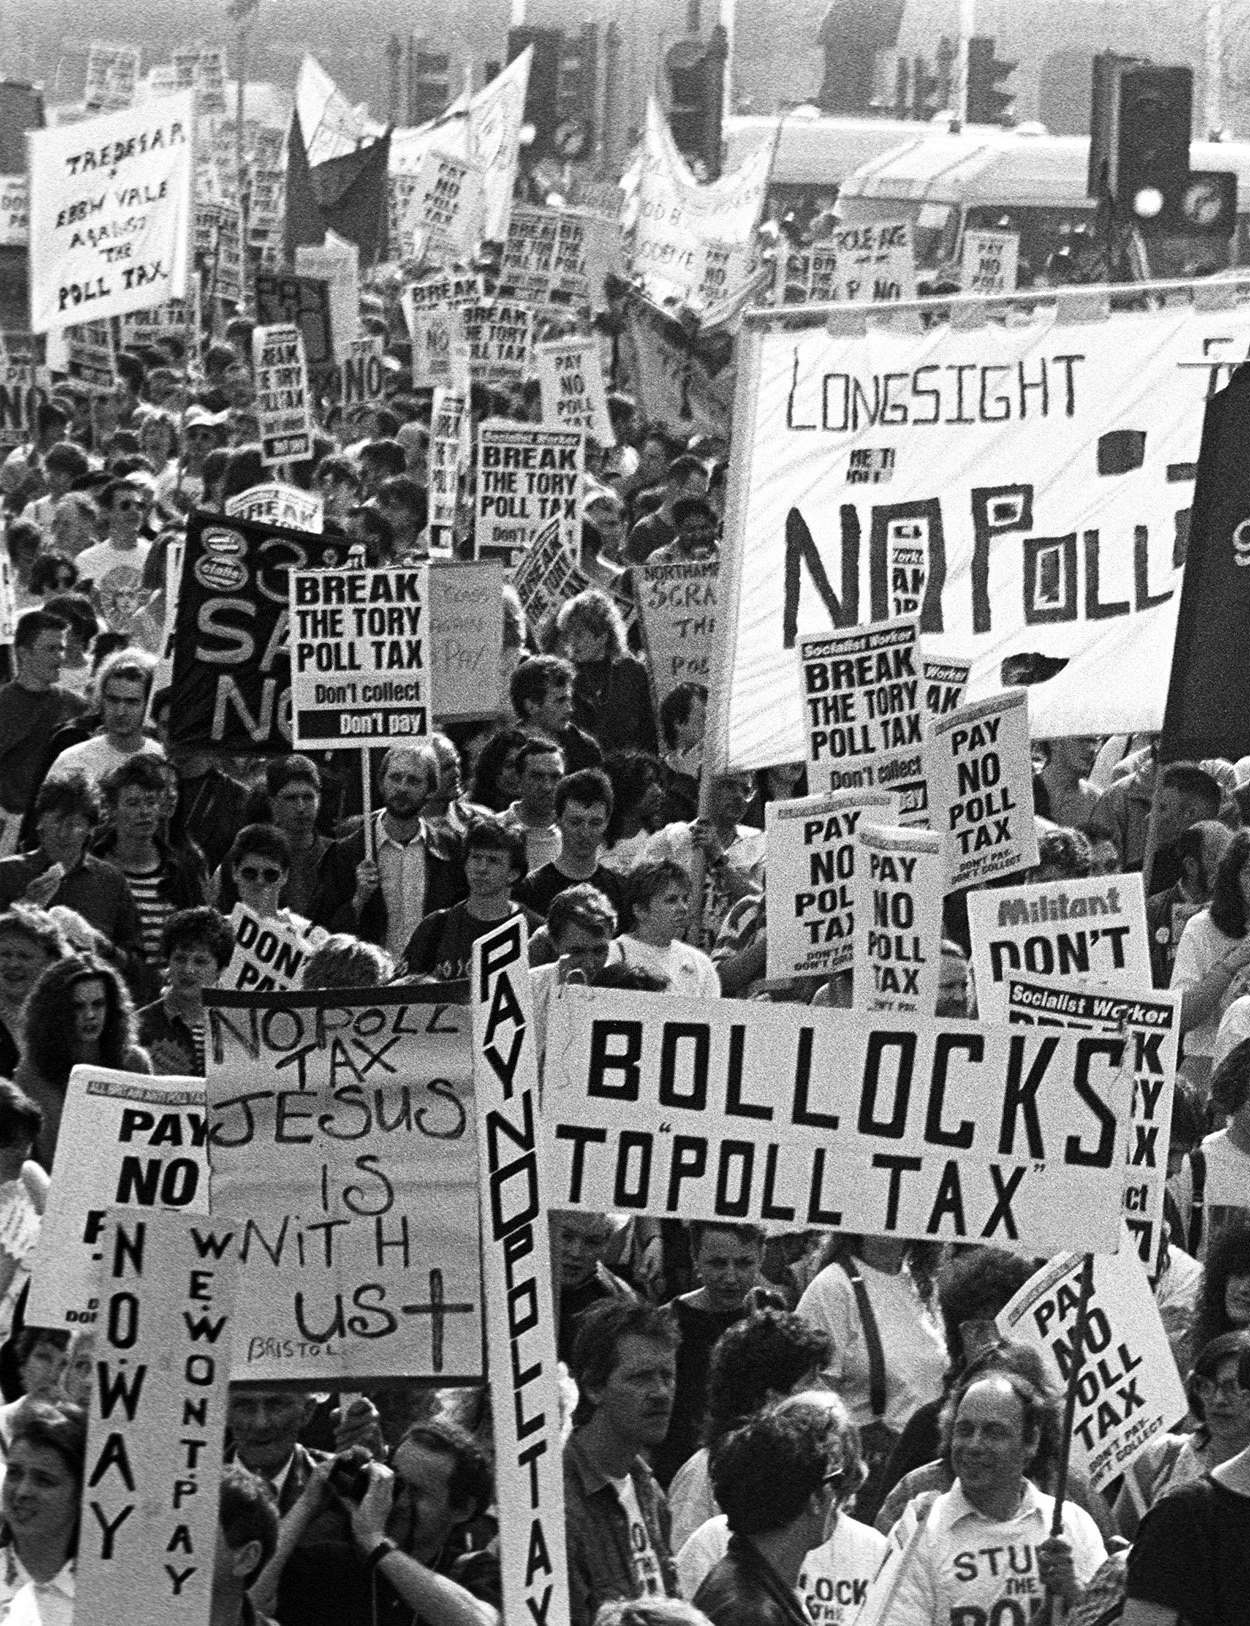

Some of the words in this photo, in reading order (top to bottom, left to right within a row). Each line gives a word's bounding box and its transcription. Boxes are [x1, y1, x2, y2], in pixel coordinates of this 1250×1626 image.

[117, 179, 168, 207] VALE
[57, 277, 111, 312] POLL
[122, 260, 169, 290] TAX
[412, 279, 478, 302] BREAK
[463, 306, 529, 324] BREAK
[560, 374, 585, 394] NO
[788, 347, 1085, 432] LONGSIGHT
[482, 446, 577, 470] BREAK
[482, 471, 517, 493] THE
[526, 472, 578, 496] TORY
[481, 496, 530, 518] POLL
[539, 498, 577, 520] TAX
[784, 497, 948, 650] NO
[971, 483, 1177, 636] POLL
[295, 574, 421, 605] BREAK
[296, 608, 344, 639] THE
[352, 606, 422, 637] TORY
[297, 642, 362, 672] POLL
[372, 640, 423, 670] TAX
[803, 637, 865, 660] Socialist
[869, 626, 915, 649] Worker
[804, 647, 917, 694] BREAK
[925, 664, 967, 682] Worker
[315, 683, 357, 704] Don't
[362, 682, 420, 702] collect
[807, 697, 857, 728] THE
[864, 680, 919, 719] TORY
[339, 712, 383, 735] Don't
[388, 713, 421, 735] pay
[811, 727, 876, 761] POLL
[883, 714, 922, 749] TAX
[950, 718, 1001, 756] PAY
[829, 766, 874, 793] Don't
[957, 753, 1001, 796] NO
[804, 811, 861, 845] PAY
[949, 788, 1017, 830] POLL
[957, 817, 1013, 855] TAX
[810, 844, 854, 886] NO
[869, 853, 917, 883] PAY
[795, 885, 854, 917] POL
[873, 890, 914, 929] NO
[998, 887, 1122, 926] Militant
[868, 930, 926, 963] POLL
[989, 925, 1130, 982] DON'T
[873, 963, 920, 995] TAX
[480, 920, 527, 1101] PAY
[1012, 985, 1086, 1015] Socialist
[1093, 1000, 1169, 1026] Worker
[208, 1006, 304, 1064] NO
[316, 1003, 459, 1050] POLL
[275, 1031, 400, 1090] TAX
[208, 1078, 467, 1147] JESUS
[587, 1019, 1130, 1170] BOLLOCKS
[118, 1108, 209, 1149] PAY
[115, 1156, 200, 1206] NO
[319, 1154, 394, 1216] IS
[486, 1089, 540, 1242] NO
[555, 1124, 655, 1208] TO
[295, 1283, 398, 1344] US
[1033, 1272, 1096, 1338] PAY
[247, 1336, 338, 1363] BRISTOL
[503, 1222, 548, 1442] POLL
[1051, 1307, 1113, 1381] NO
[1073, 1376, 1149, 1452] TAX
[1115, 1415, 1165, 1463] COLLECT
[953, 1543, 1040, 1582] STU
[1005, 1577, 1039, 1595] THE
